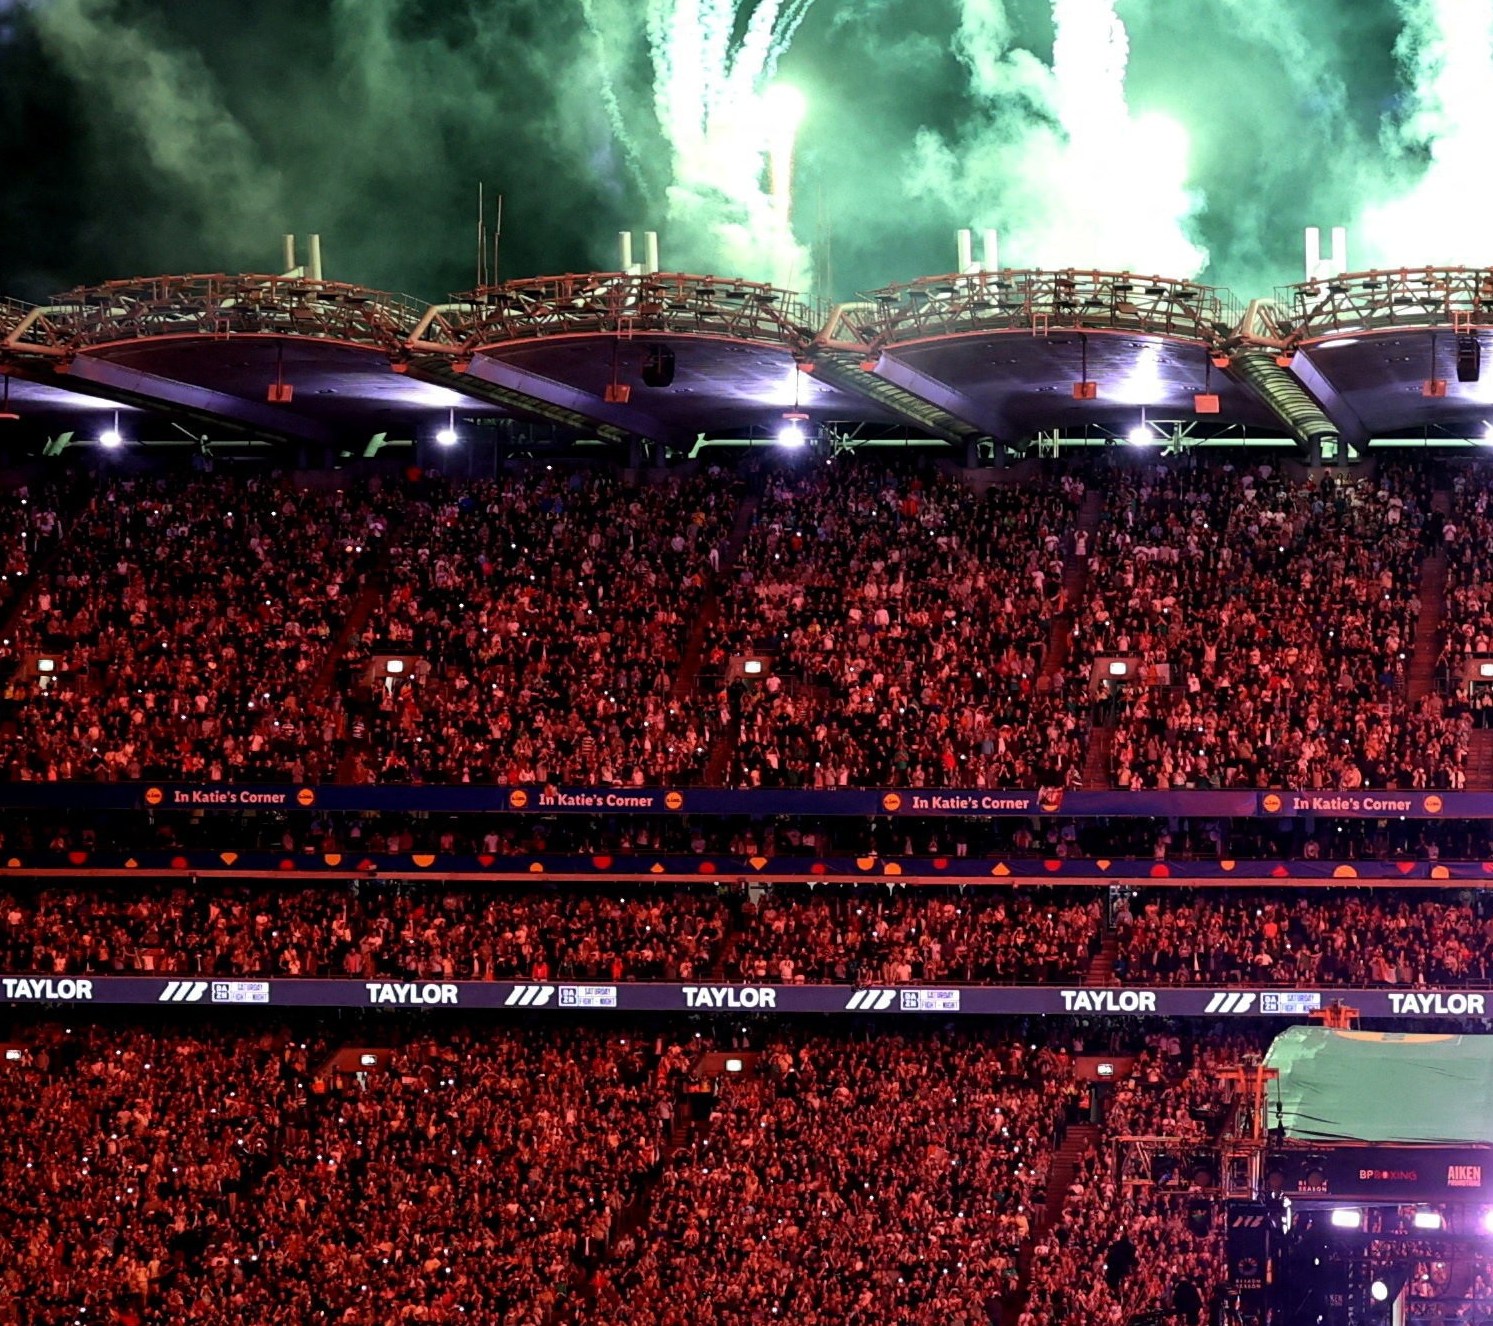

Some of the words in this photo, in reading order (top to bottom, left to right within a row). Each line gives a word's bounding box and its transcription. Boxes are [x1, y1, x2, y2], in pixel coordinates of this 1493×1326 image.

[175, 791, 188, 802] In
[193, 790, 236, 802] Katie's
[240, 791, 285, 803] Corner
[539, 794, 554, 805] In
[558, 794, 603, 806] Katie's
[607, 794, 653, 806] Corner
[913, 797, 928, 808] In
[932, 796, 978, 809] Katie's
[982, 797, 1029, 809] Corner
[1294, 798, 1309, 809] In
[1313, 797, 1359, 810] Katie's
[1363, 798, 1411, 810] Corner
[3, 979, 92, 999] TAYLOR
[366, 984, 457, 1004] TAYLOR
[683, 987, 775, 1007] TAYLOR
[1061, 991, 1155, 1011] TAYLOR
[1389, 994, 1484, 1014] TAYLOR
[1447, 1166, 1481, 1180] AIKEN
